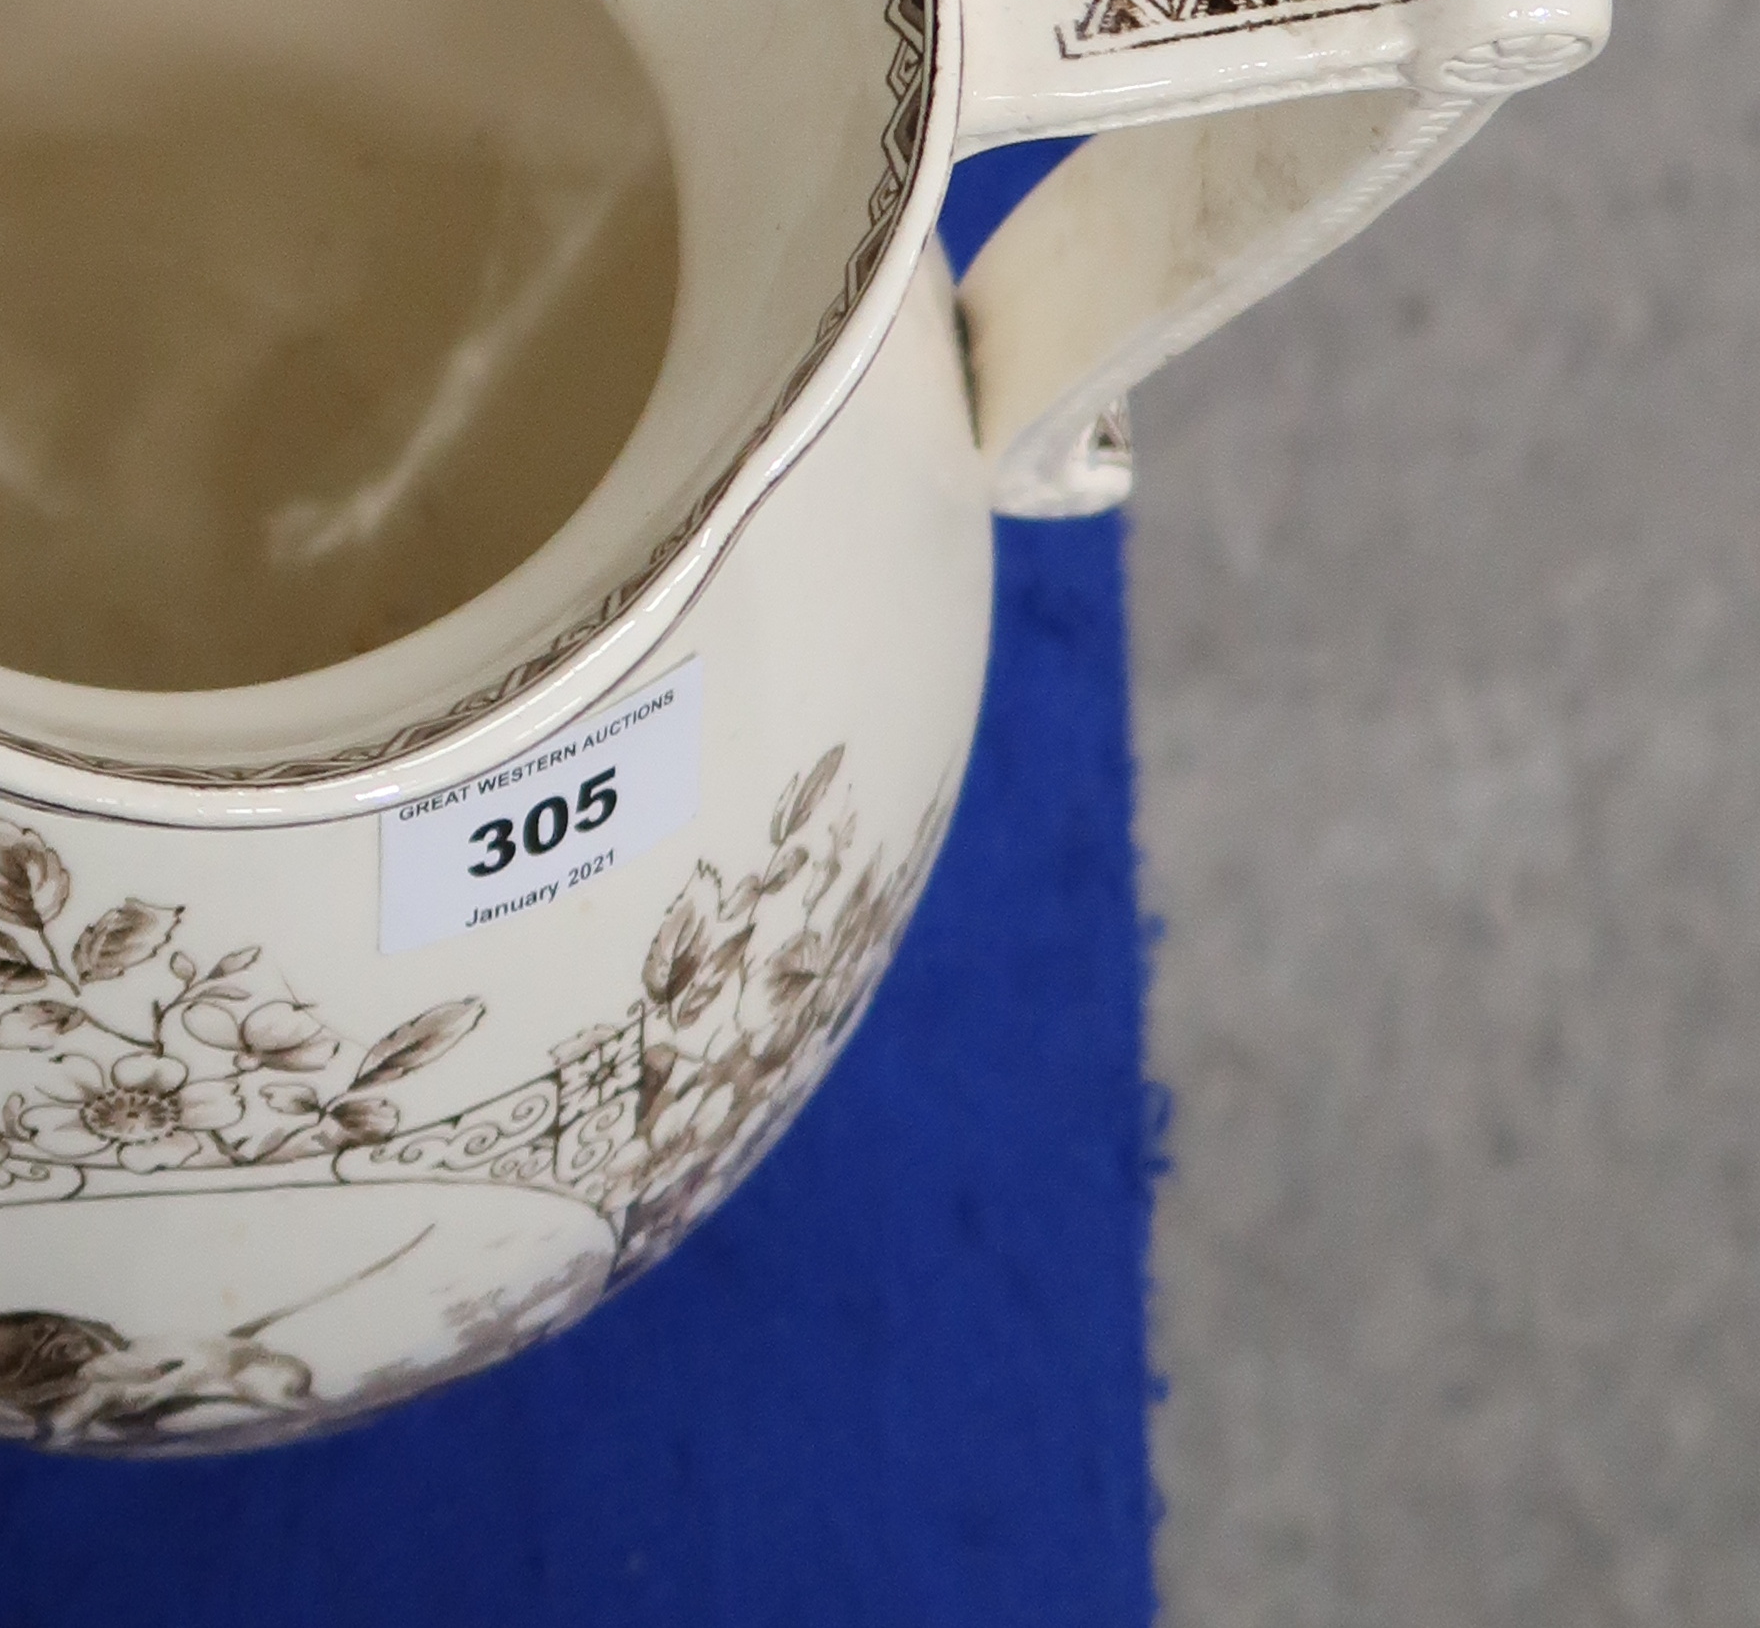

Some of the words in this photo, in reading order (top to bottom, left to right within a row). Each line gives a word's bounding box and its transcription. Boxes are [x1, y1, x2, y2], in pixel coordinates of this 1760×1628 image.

[398, 785, 471, 821] GREAT
[477, 743, 577, 795] WESTERN
[581, 689, 675, 752] AUCTIONS
[467, 766, 618, 878] 305
[465, 882, 559, 927] January
[568, 848, 615, 888] 2021
